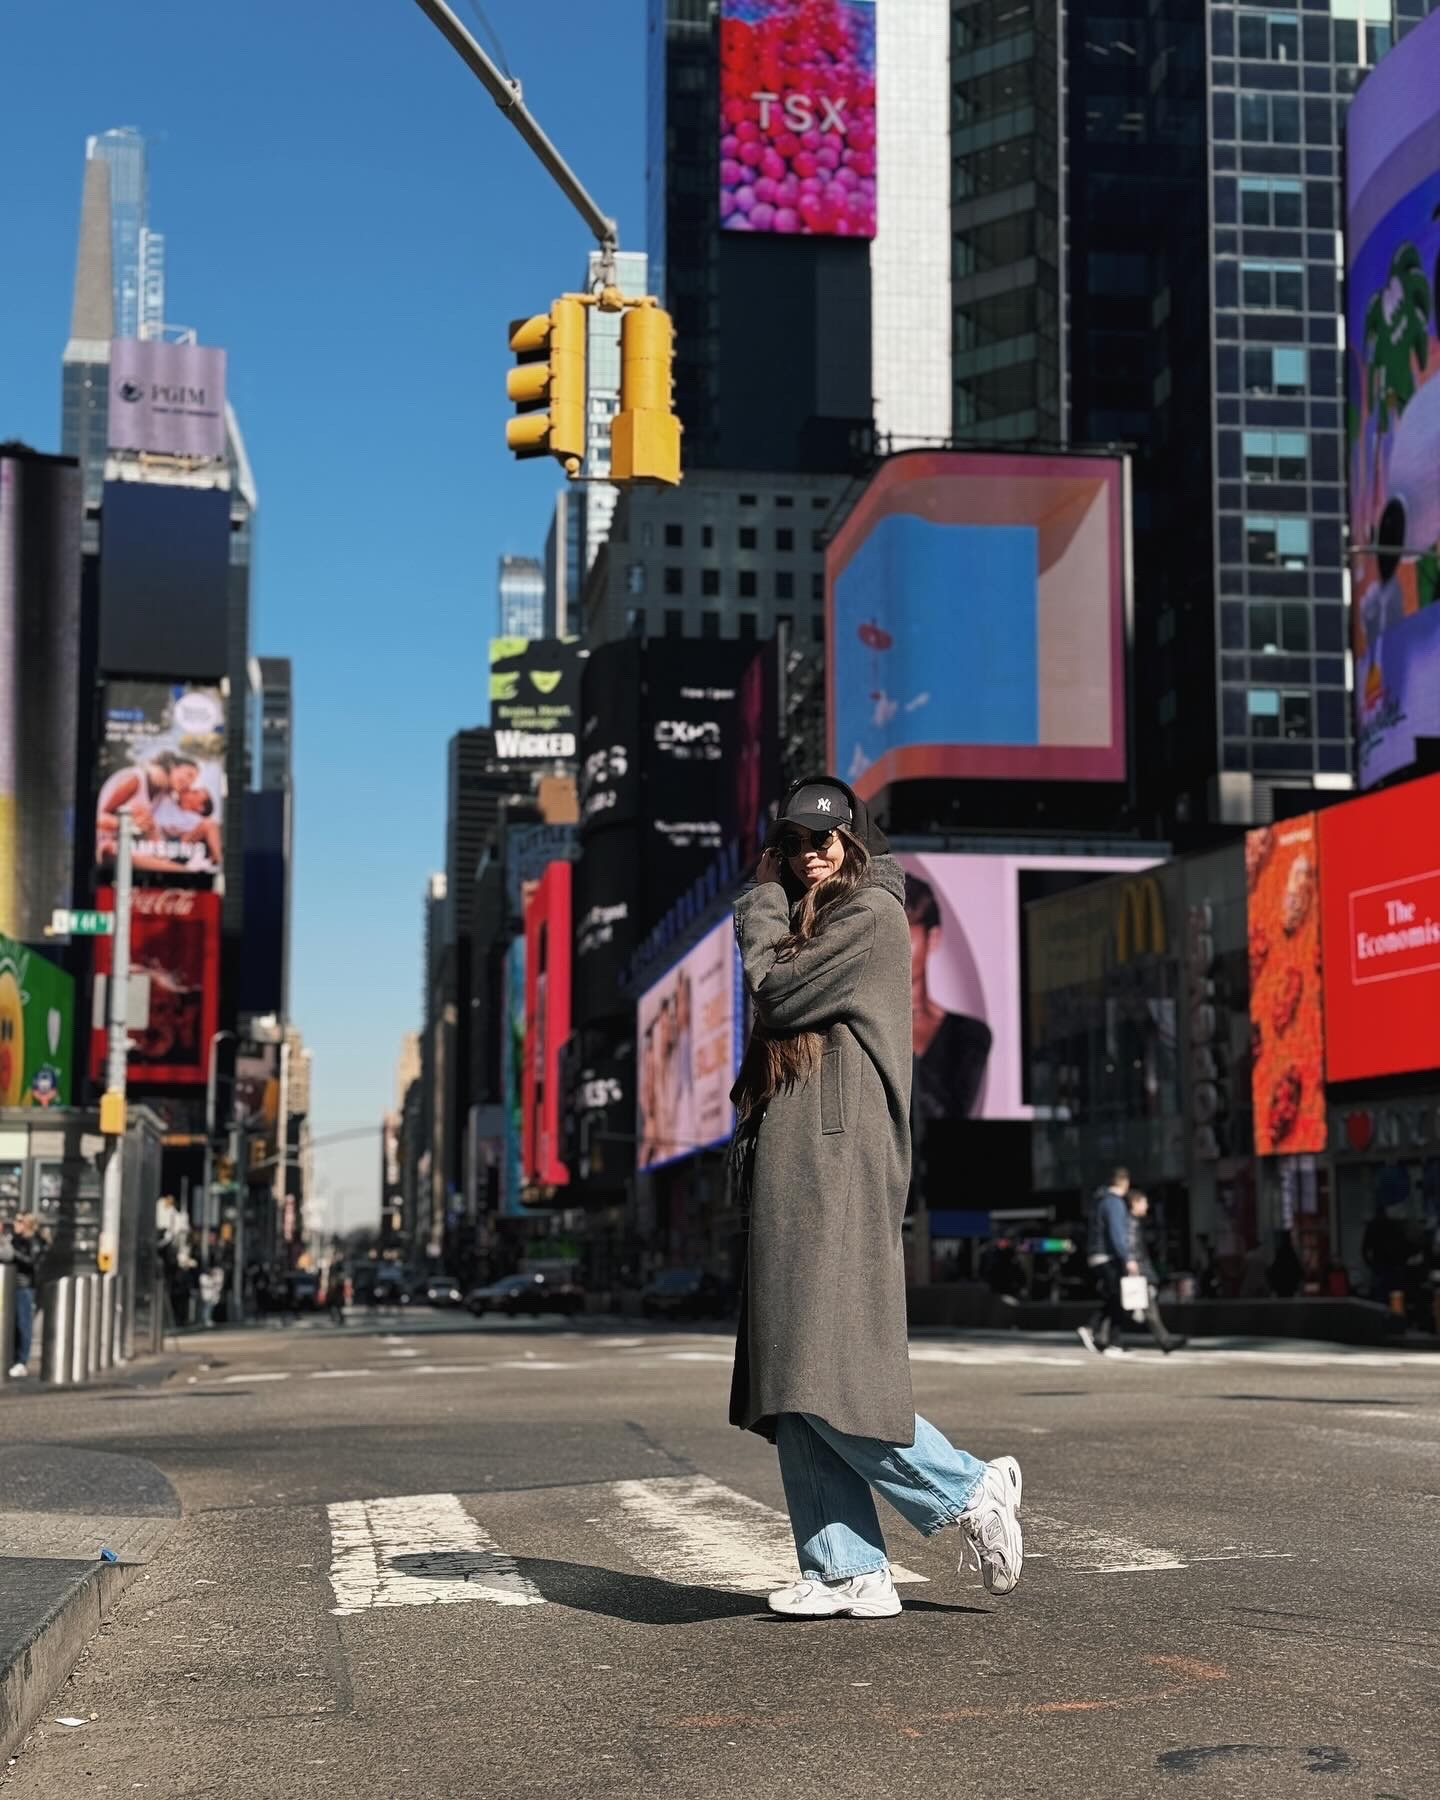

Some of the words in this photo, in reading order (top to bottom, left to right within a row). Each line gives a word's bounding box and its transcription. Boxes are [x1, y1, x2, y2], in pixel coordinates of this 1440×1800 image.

[751, 92, 848, 134] TSX
[817, 798, 832, 811] NY
[129, 839, 207, 860] AMSUNG
[1384, 899, 1417, 926] The
[1357, 916, 1440, 960] Economis
